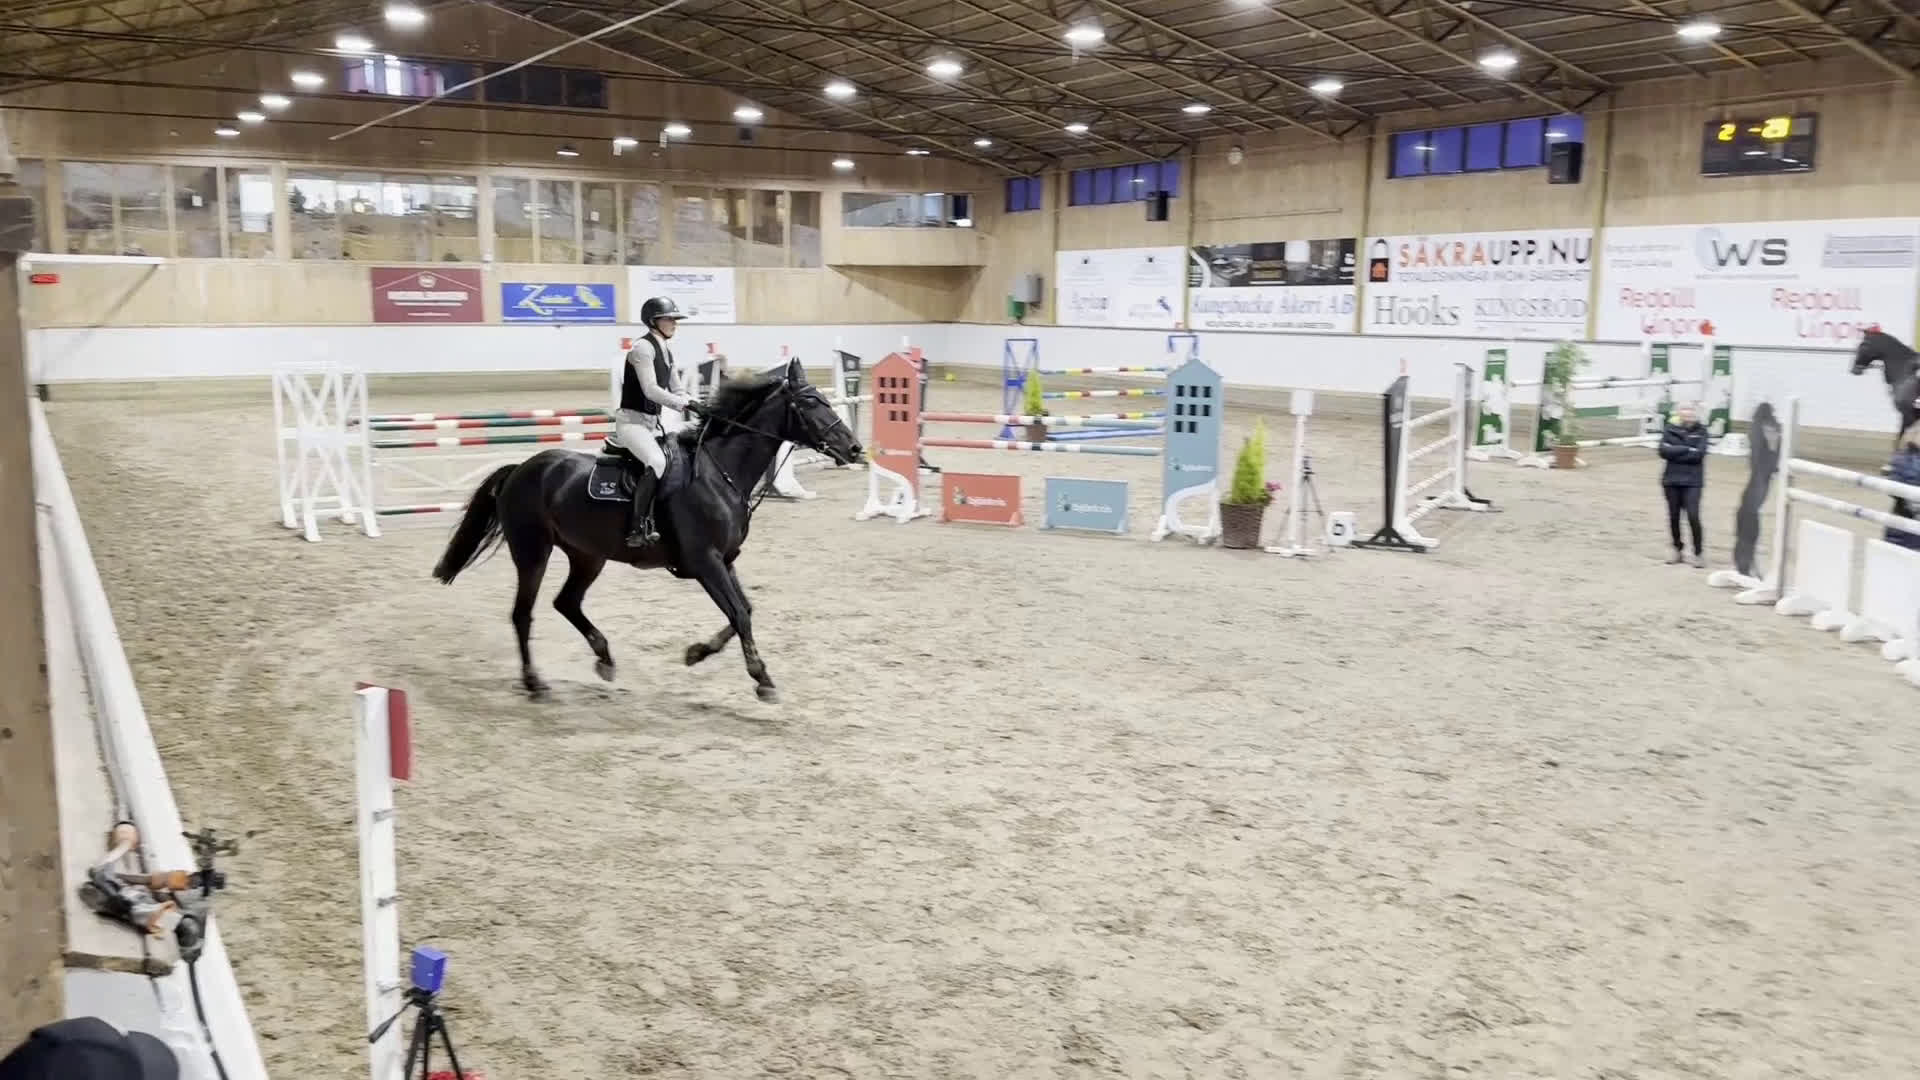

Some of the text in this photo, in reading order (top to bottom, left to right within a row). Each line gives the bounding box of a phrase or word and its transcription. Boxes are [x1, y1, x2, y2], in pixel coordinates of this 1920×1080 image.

[1399, 237, 1592, 267] SÄKRAUPP.NU
[1711, 238, 1788, 266] WS
[1372, 293, 1461, 326] Hööks
[1620, 287, 1695, 308] Redpill
[1772, 287, 1861, 310] Redpill
